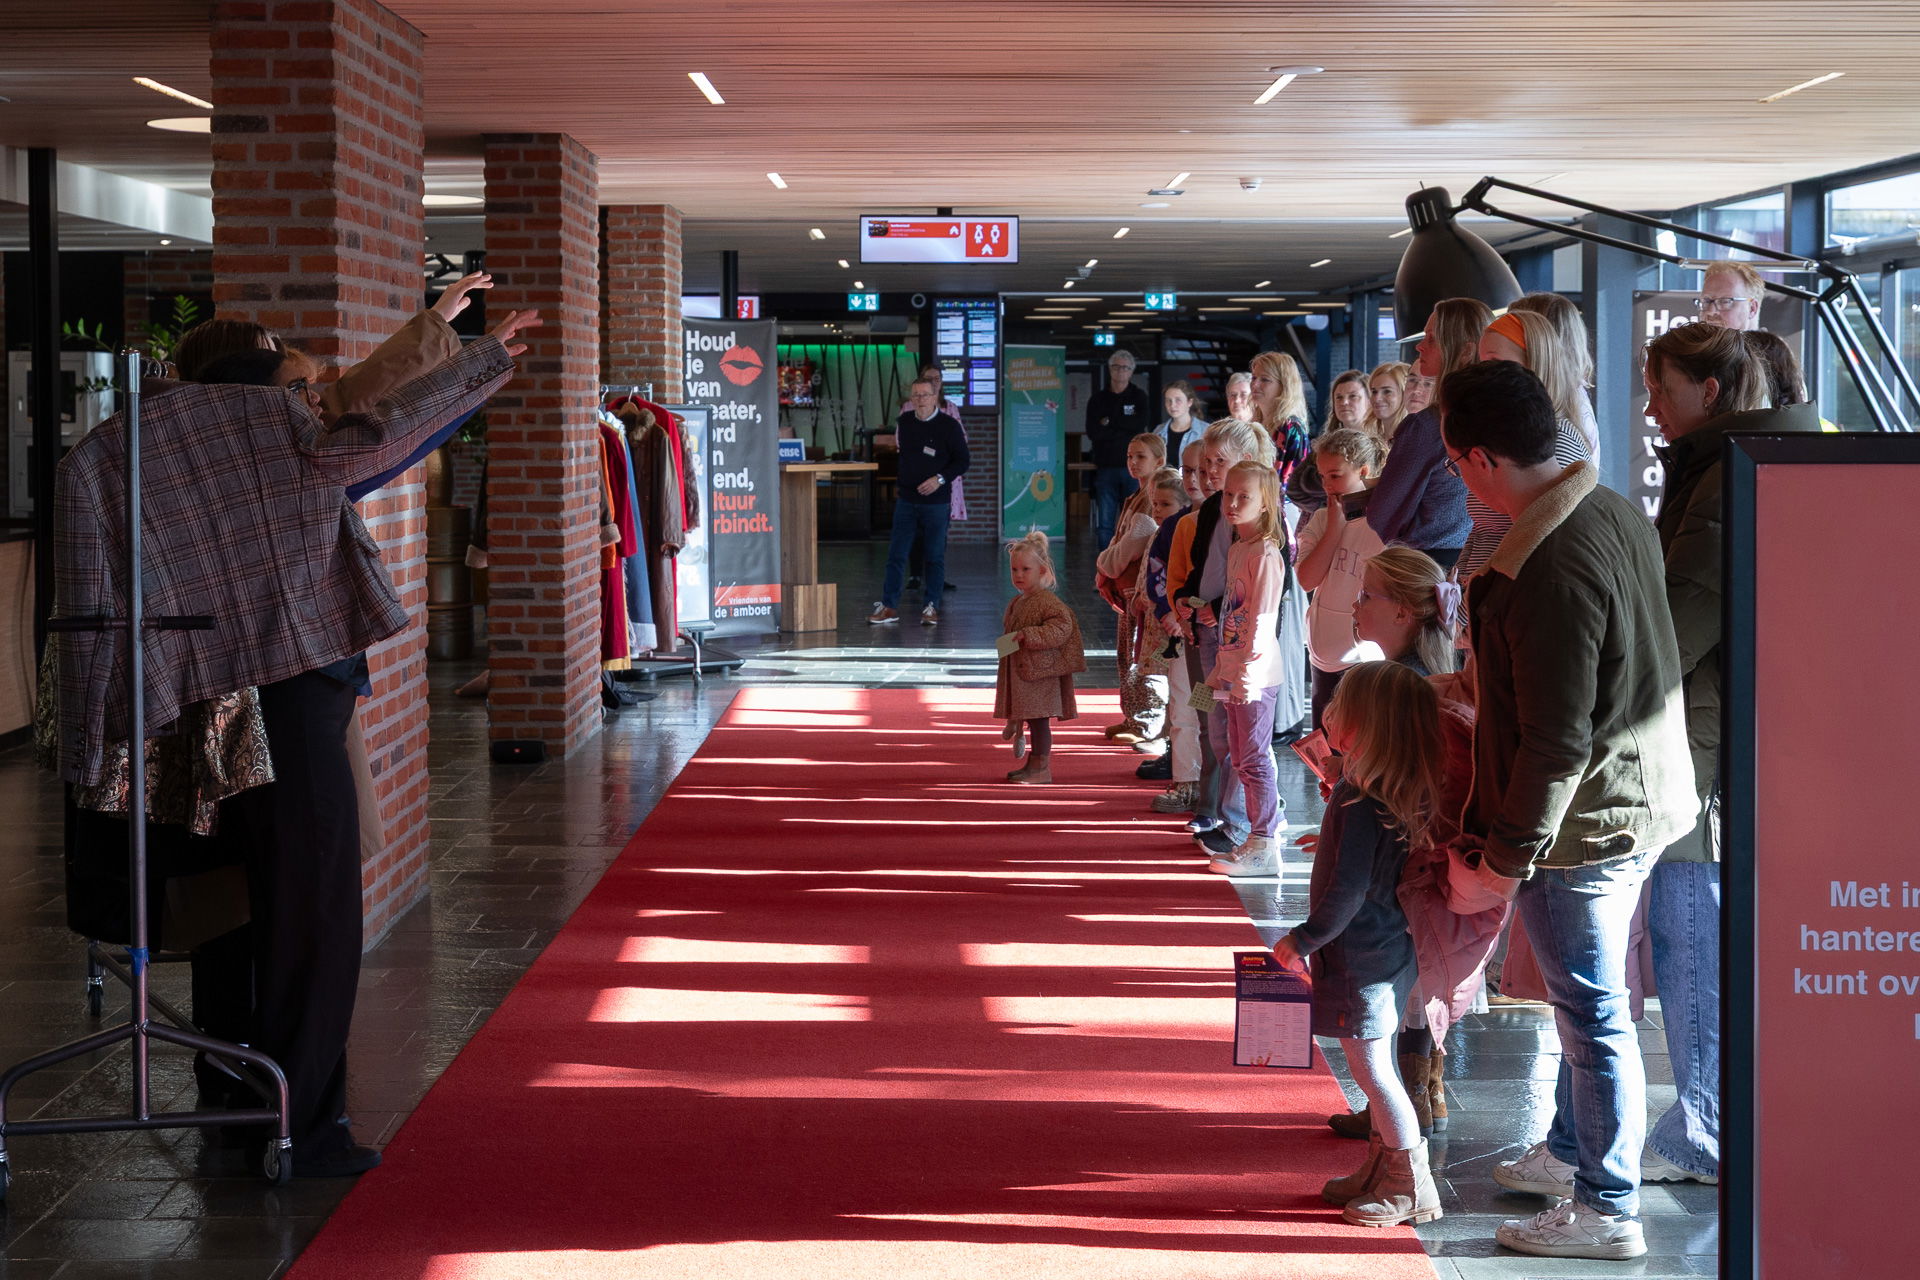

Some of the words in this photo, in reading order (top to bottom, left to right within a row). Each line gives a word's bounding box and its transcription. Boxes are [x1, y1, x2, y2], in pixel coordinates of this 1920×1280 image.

[686, 330, 736, 352] Houd
[685, 352, 704, 380] je
[686, 381, 722, 398] van
[688, 400, 762, 424] eater,
[713, 467, 754, 492] end,
[713, 491, 756, 512] ltuur
[713, 512, 774, 535] rbindt.
[714, 606, 727, 618] de
[728, 596, 758, 605] Vrienden
[1830, 881, 1891, 908] Met
[1794, 967, 1868, 995] kunt
[1879, 975, 1920, 996] ov
